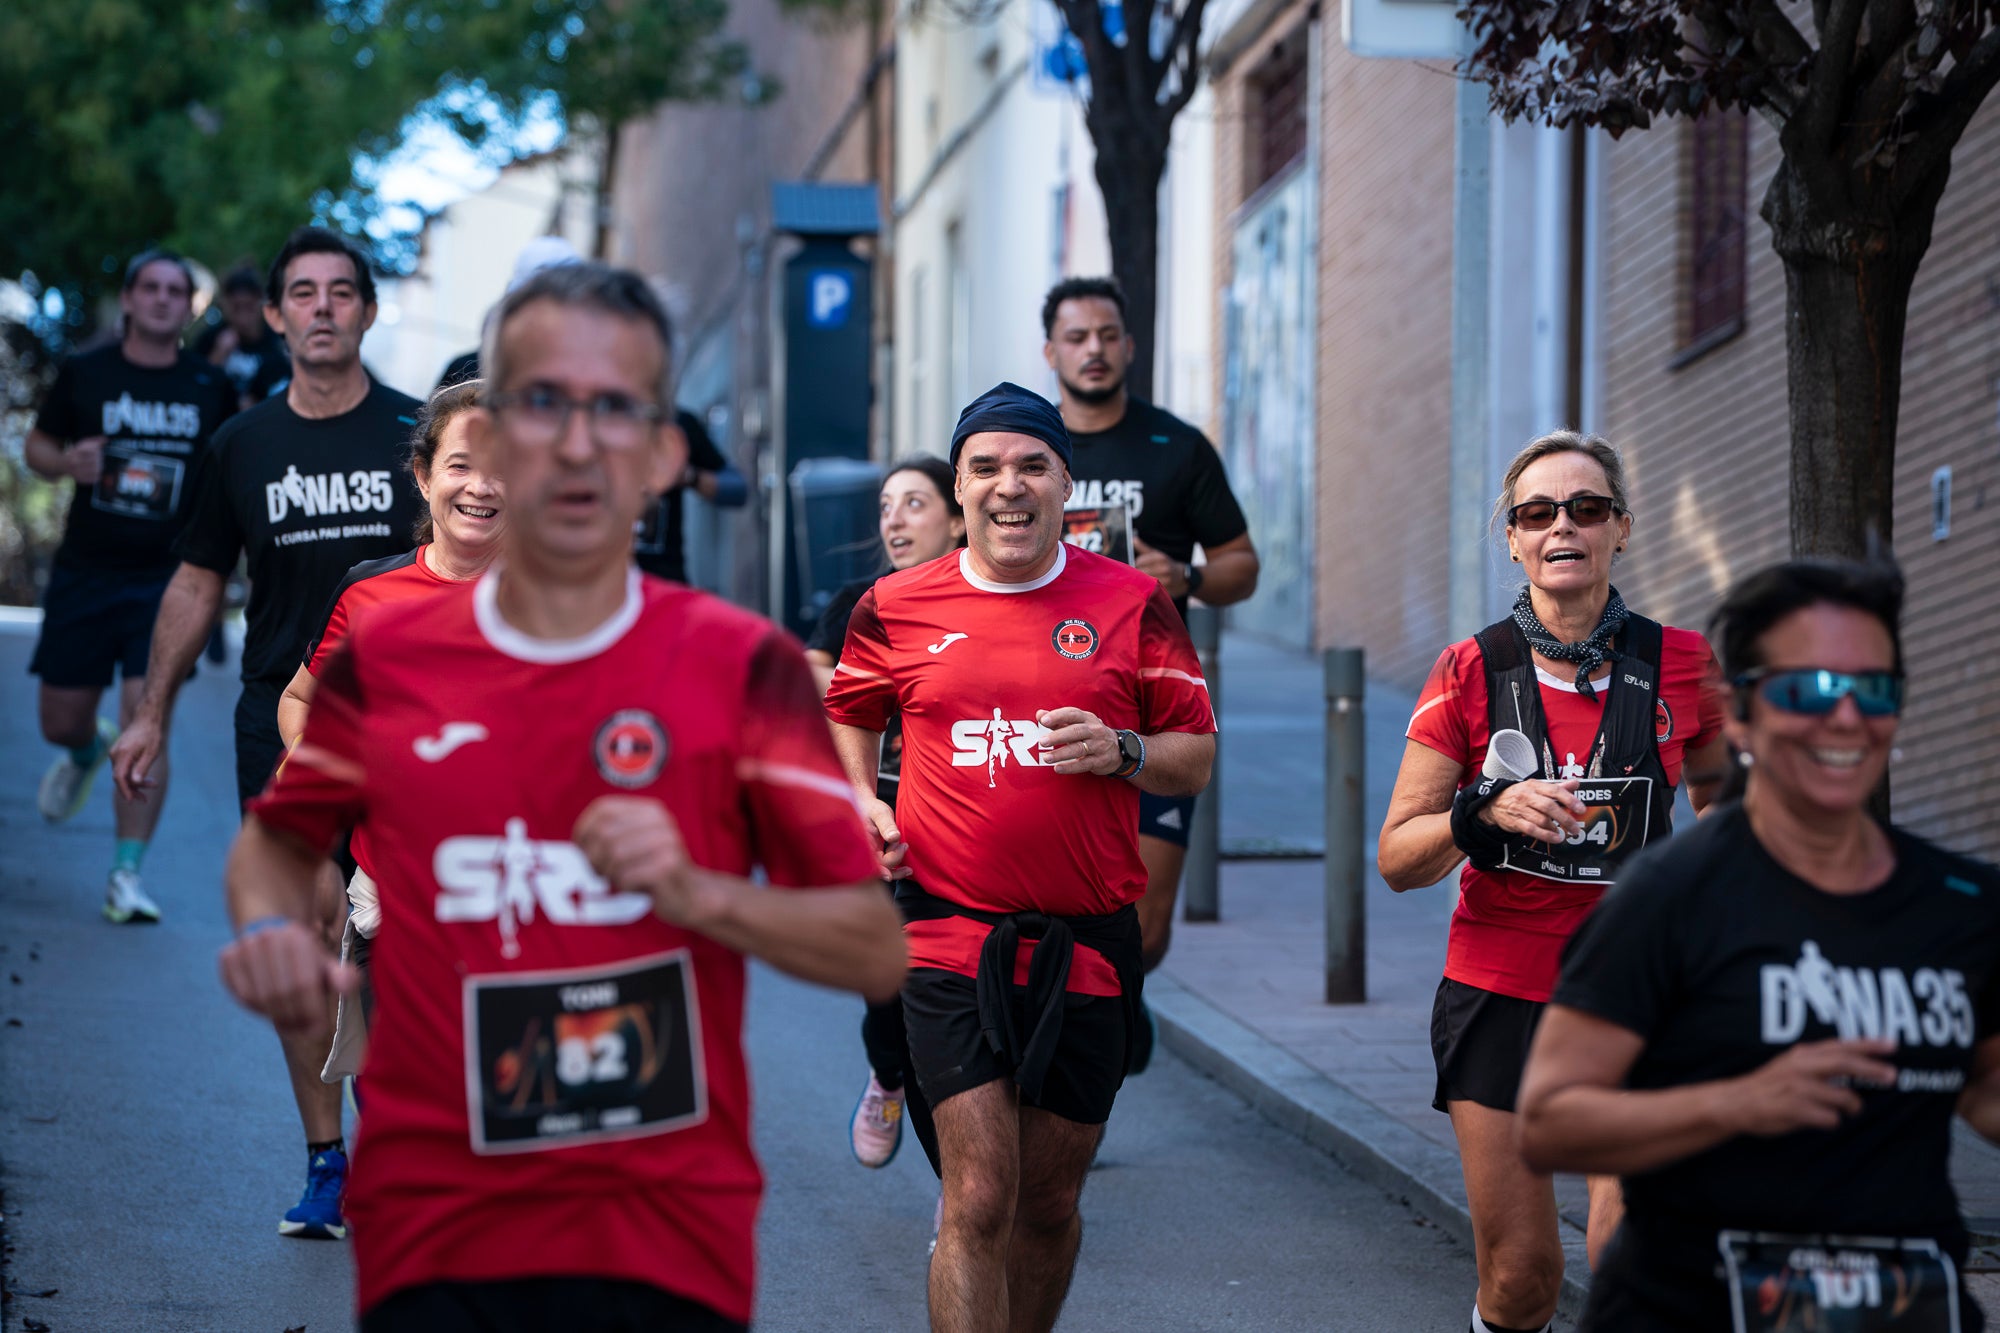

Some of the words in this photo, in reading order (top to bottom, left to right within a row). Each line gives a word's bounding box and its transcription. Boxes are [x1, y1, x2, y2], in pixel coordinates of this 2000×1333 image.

[813, 274, 850, 321] P
[318, 525, 341, 541] PAU
[1061, 634, 1089, 644] SRD
[1060, 650, 1073, 658] SANT
[1074, 651, 1092, 659] CUGAT
[1573, 789, 1613, 801] RDES
[555, 1031, 630, 1087] 82
[1811, 1268, 1882, 1309] 101
